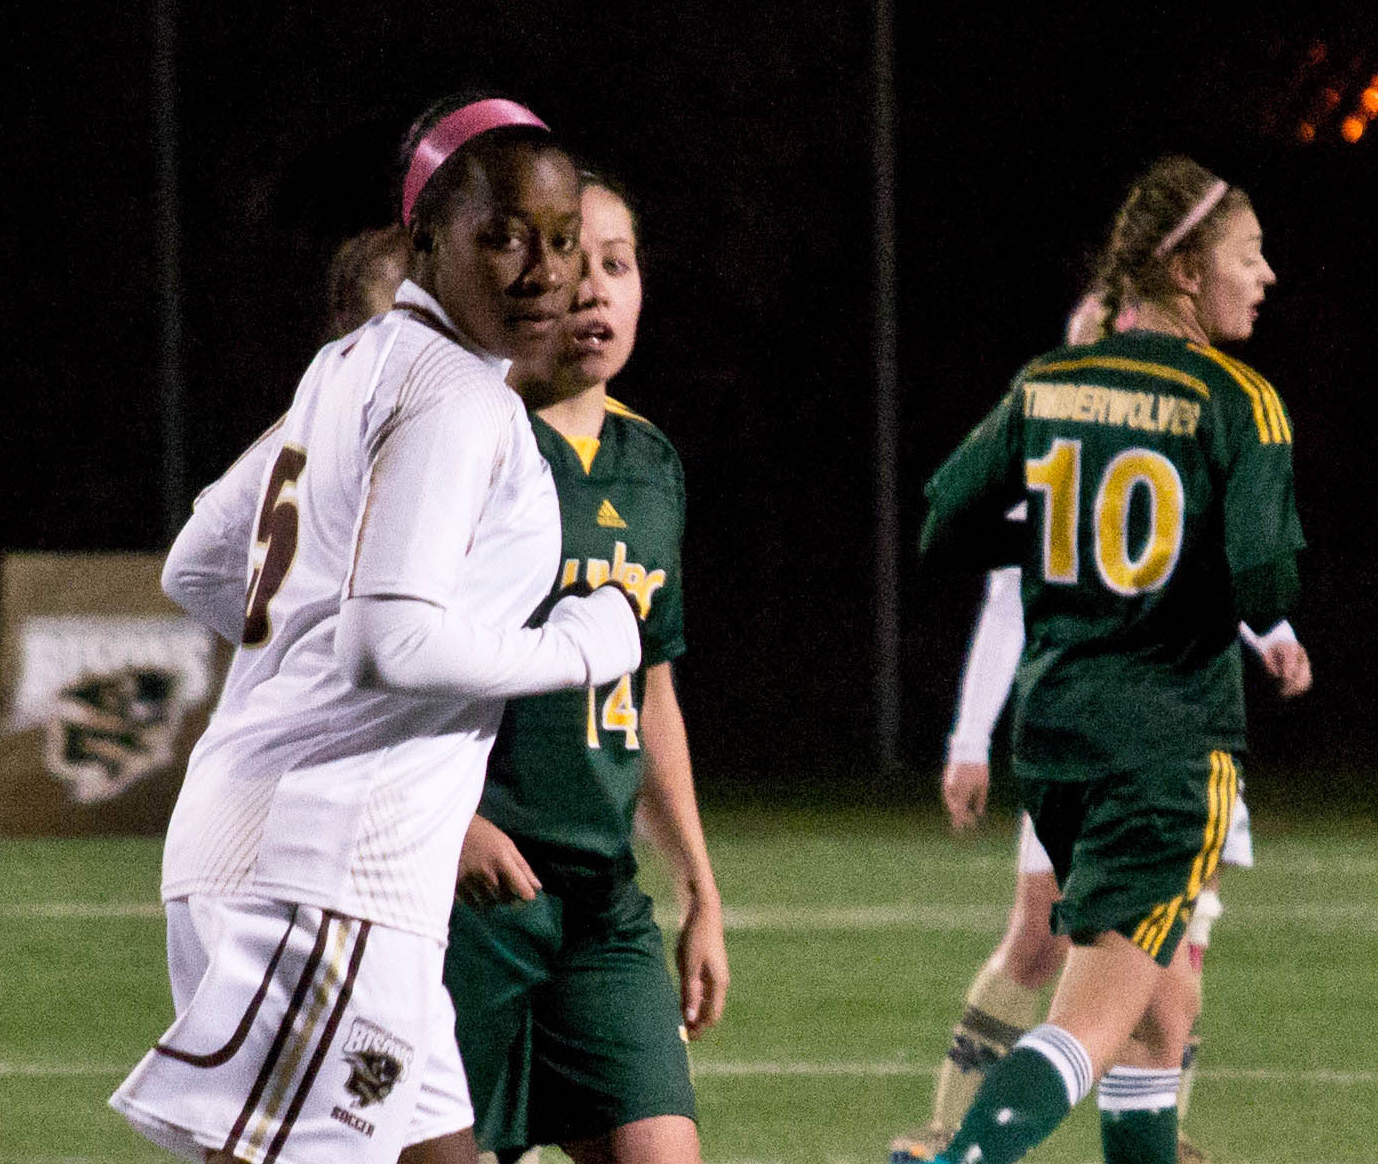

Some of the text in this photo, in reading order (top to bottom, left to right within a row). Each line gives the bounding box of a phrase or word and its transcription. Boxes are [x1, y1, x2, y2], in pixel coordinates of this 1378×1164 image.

[241, 441, 307, 649] 5
[1025, 438, 1185, 596] 10
[586, 673, 640, 749] 14
